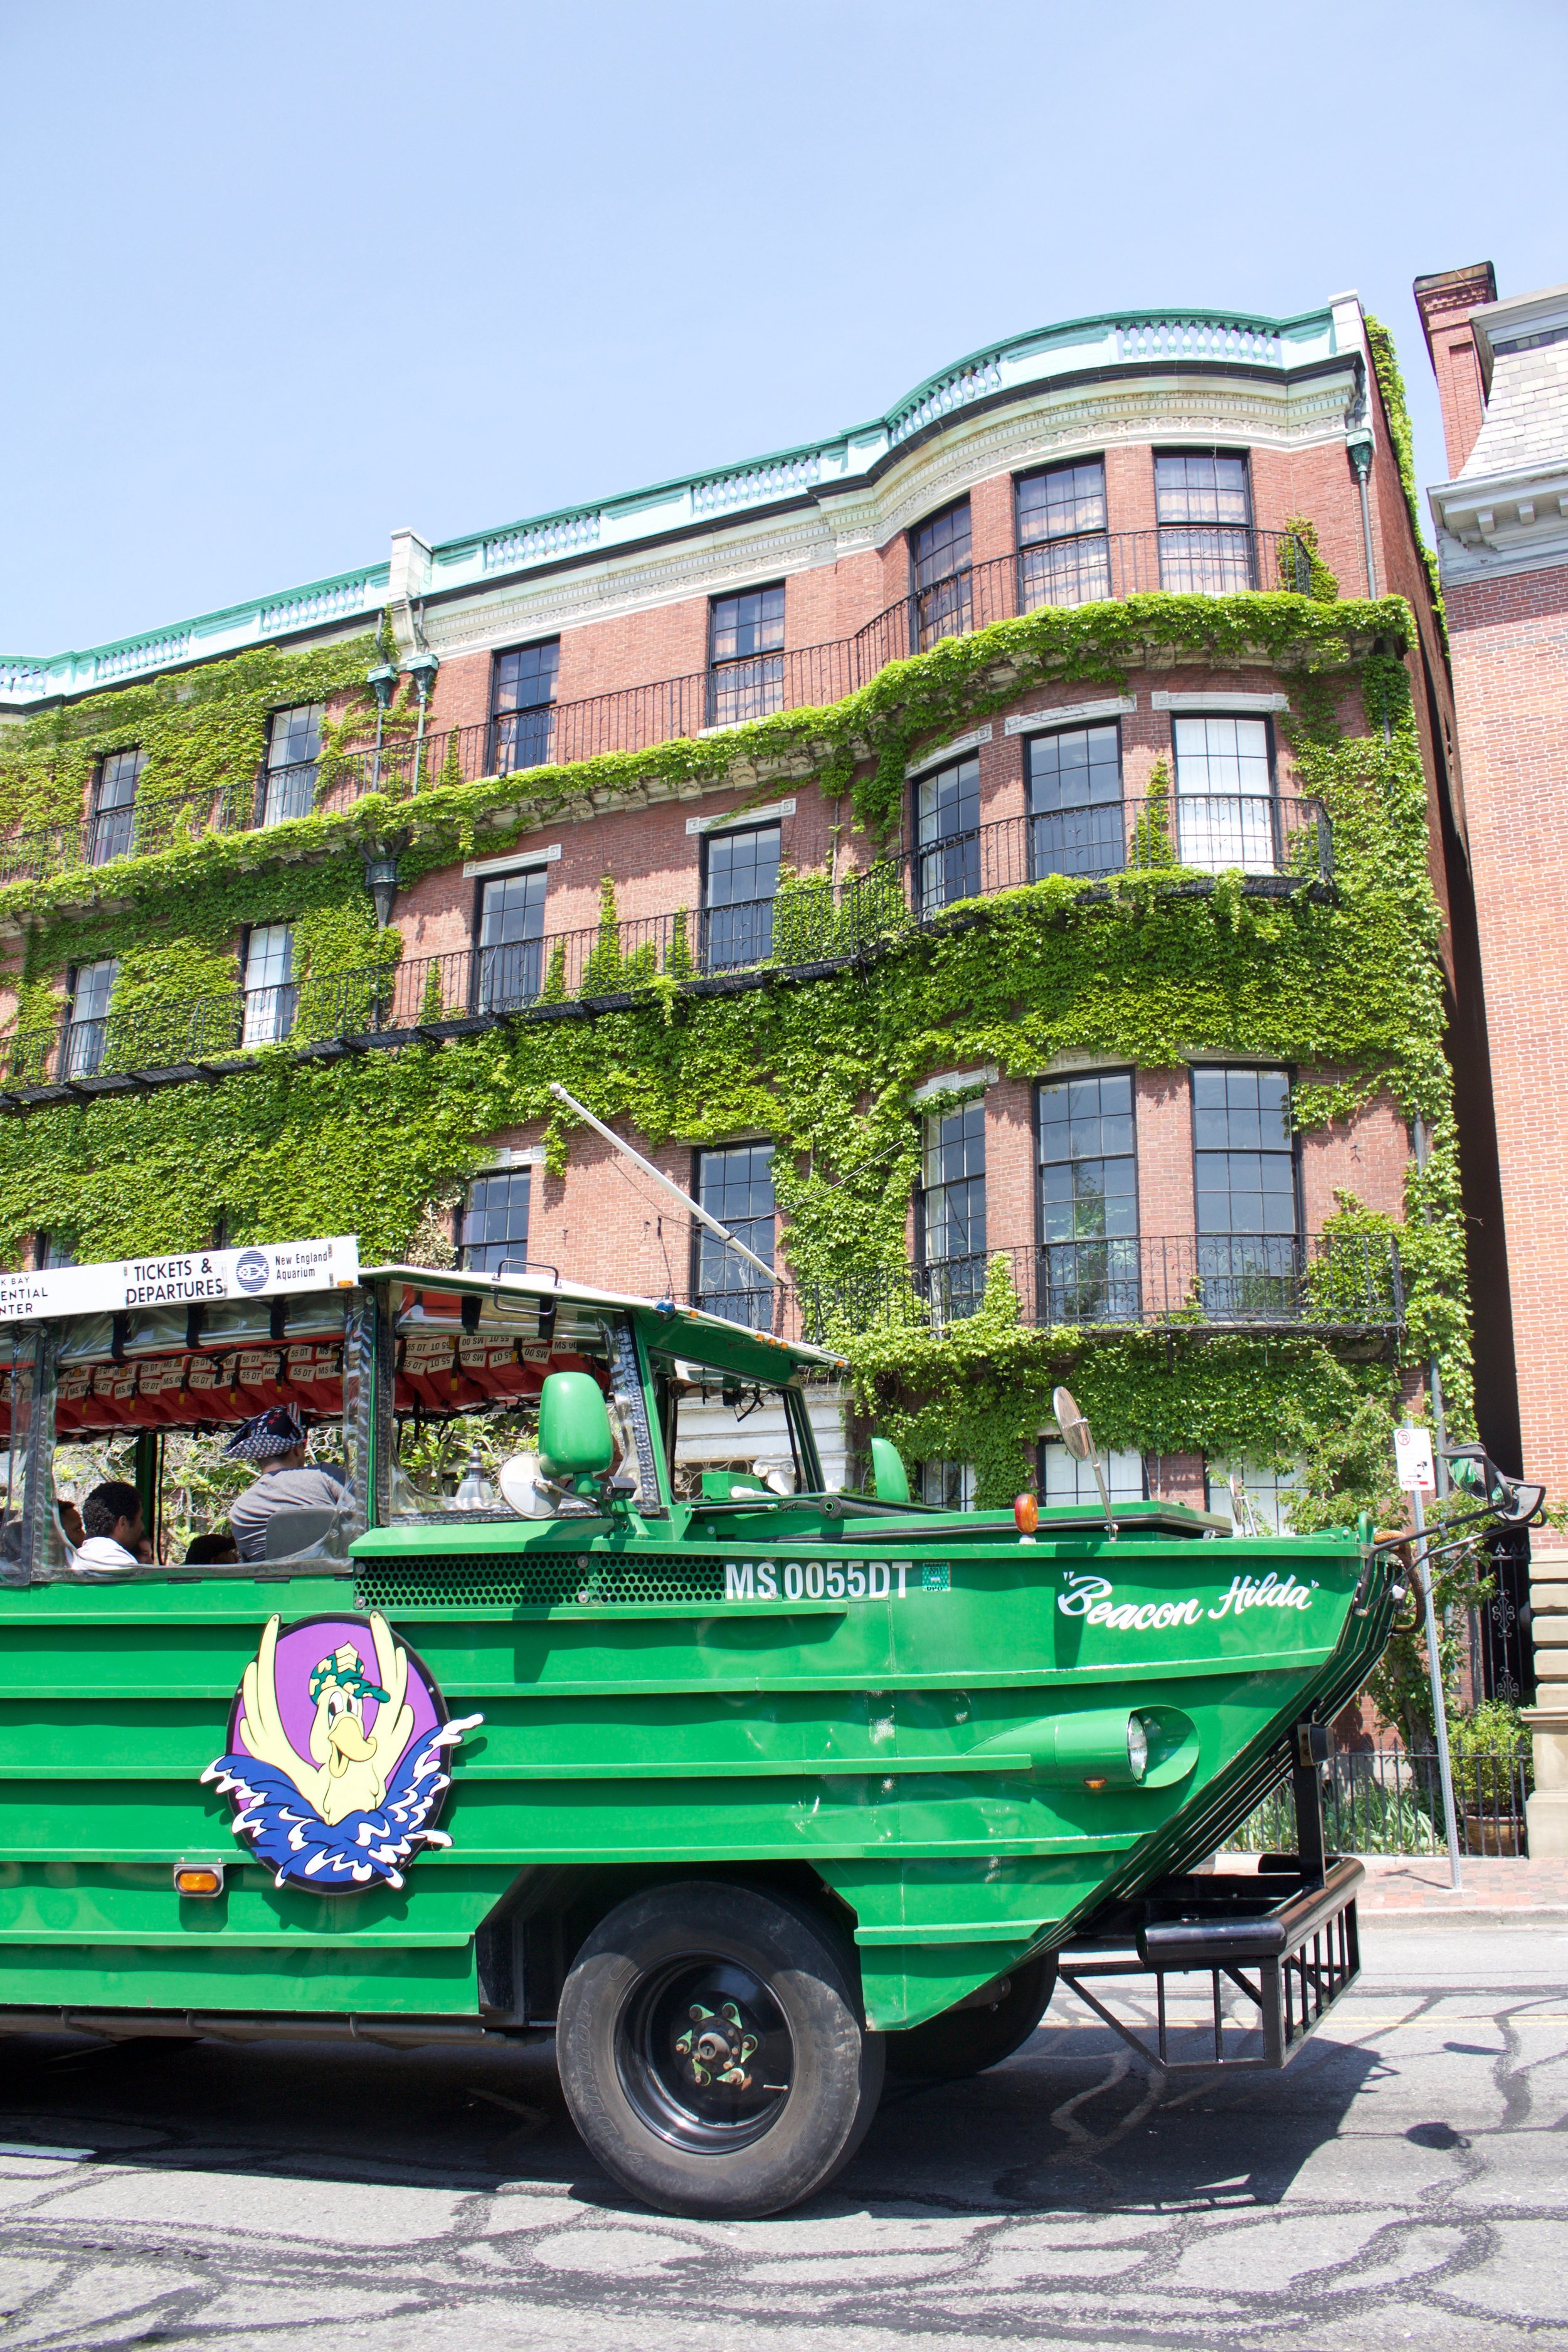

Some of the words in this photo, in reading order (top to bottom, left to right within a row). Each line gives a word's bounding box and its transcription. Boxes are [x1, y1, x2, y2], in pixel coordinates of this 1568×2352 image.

[275, 1255, 292, 1266] New
[296, 1251, 327, 1264] England
[134, 1260, 192, 1281] TICKETS
[201, 1258, 213, 1274] &
[277, 1268, 315, 1281] Aquarium
[11, 1276, 30, 1285] BAY
[1, 1287, 49, 1301] ENTIAL
[127, 1278, 224, 1304] DEPARTURES
[0, 1303, 33, 1316] NTER
[472, 1337, 484, 1345] MS
[554, 1341, 566, 1349] MS
[430, 1343, 439, 1351] DT
[300, 1348, 308, 1357] DT
[536, 1350, 548, 1359] MS
[442, 1356, 450, 1365] 55
[472, 1353, 484, 1362] MS
[493, 1353, 502, 1362] DT
[413, 1362, 423, 1370] DT
[430, 1359, 440, 1368] DT
[302, 1369, 312, 1377] DT
[115, 1385, 125, 1394] MS
[251, 1426, 268, 1436] USA
[726, 1561, 778, 1600] MS
[784, 1560, 913, 1600] 0055DT
[576, 1999, 619, 2137] DUNLOP
